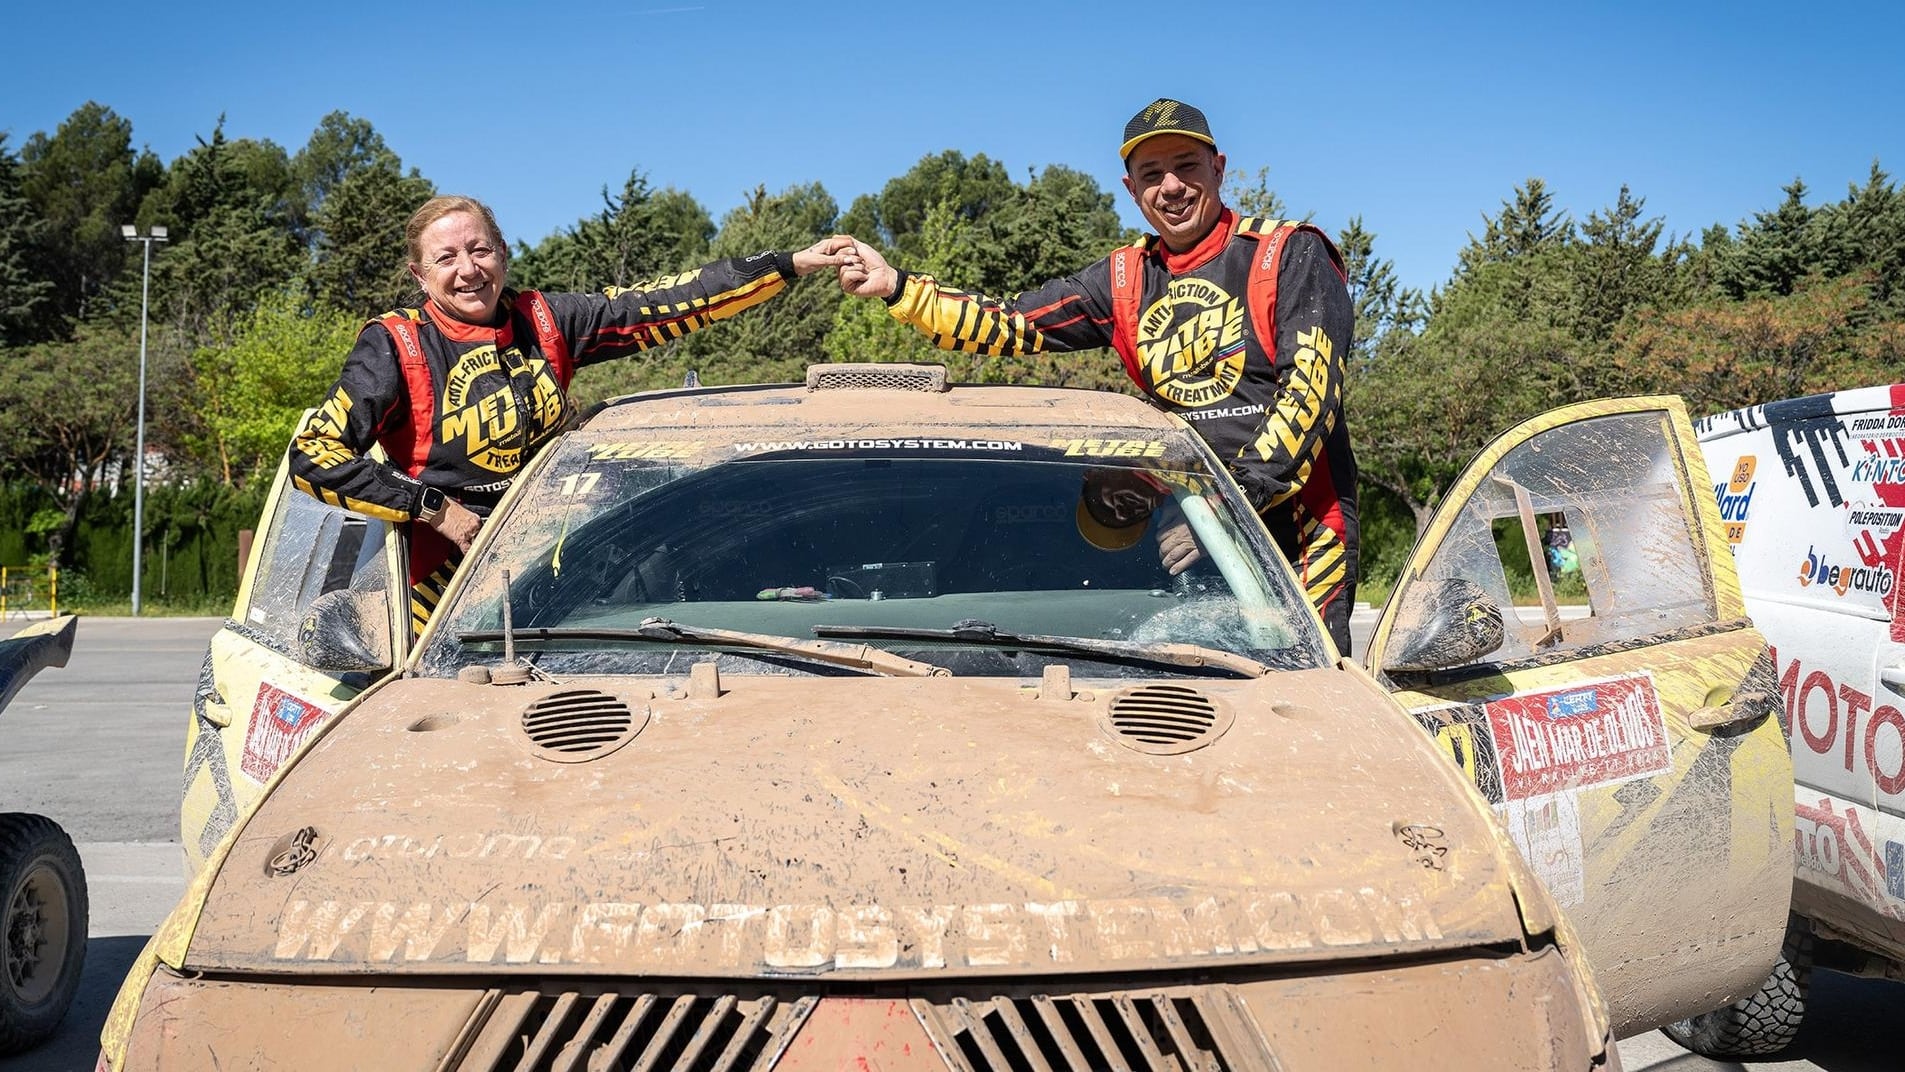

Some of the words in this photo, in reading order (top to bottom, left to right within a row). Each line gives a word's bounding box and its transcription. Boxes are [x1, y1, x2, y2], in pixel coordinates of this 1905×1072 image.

[1166, 361, 1239, 403] TREATMNT
[1179, 403, 1264, 421] SYSTEM.COM
[1851, 417, 1885, 430] FRIDDA
[734, 439, 1022, 451] WWW.GOTOSYSTEM.COM
[1738, 463, 1749, 472] YO
[558, 472, 602, 496] 17
[1715, 482, 1757, 521] llard
[1817, 554, 1892, 596] begrauto
[1506, 709, 1550, 774] JAÉN
[1550, 722, 1587, 766] MAR
[1583, 719, 1606, 759] DE
[1603, 685, 1654, 754] OLIVOS
